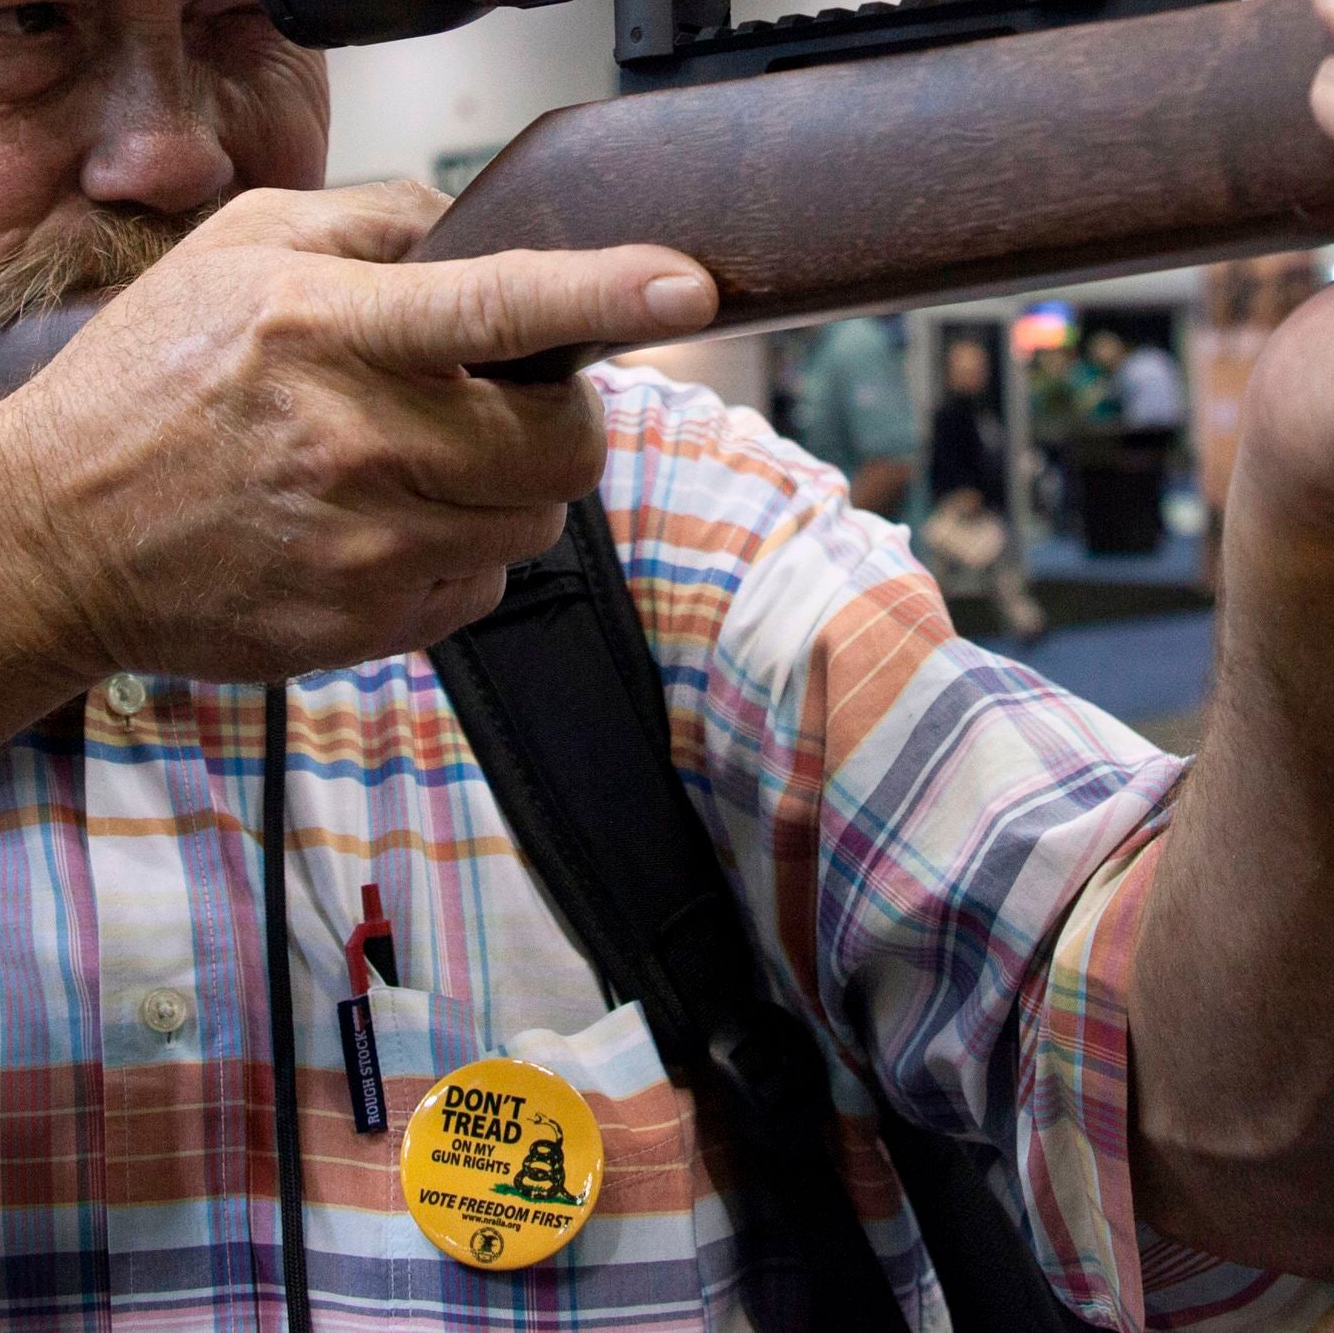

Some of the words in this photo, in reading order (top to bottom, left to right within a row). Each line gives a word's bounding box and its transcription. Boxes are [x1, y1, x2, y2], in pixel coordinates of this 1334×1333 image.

[355, 1029, 373, 1076] STOCK
[362, 1077, 381, 1126] ROUGH
[444, 1085, 526, 1120] DON'T
[442, 1110, 522, 1144] TREAD
[432, 1149, 461, 1167] GUN
[463, 1153, 511, 1175] RIGHTS
[452, 1138, 472, 1154] ON
[474, 1141, 496, 1158] MY
[419, 1188, 458, 1211] VOTE
[458, 1196, 530, 1224] FREEDOM
[531, 1210, 574, 1230] FIRST
[461, 1213, 521, 1232] www.nraila.org
